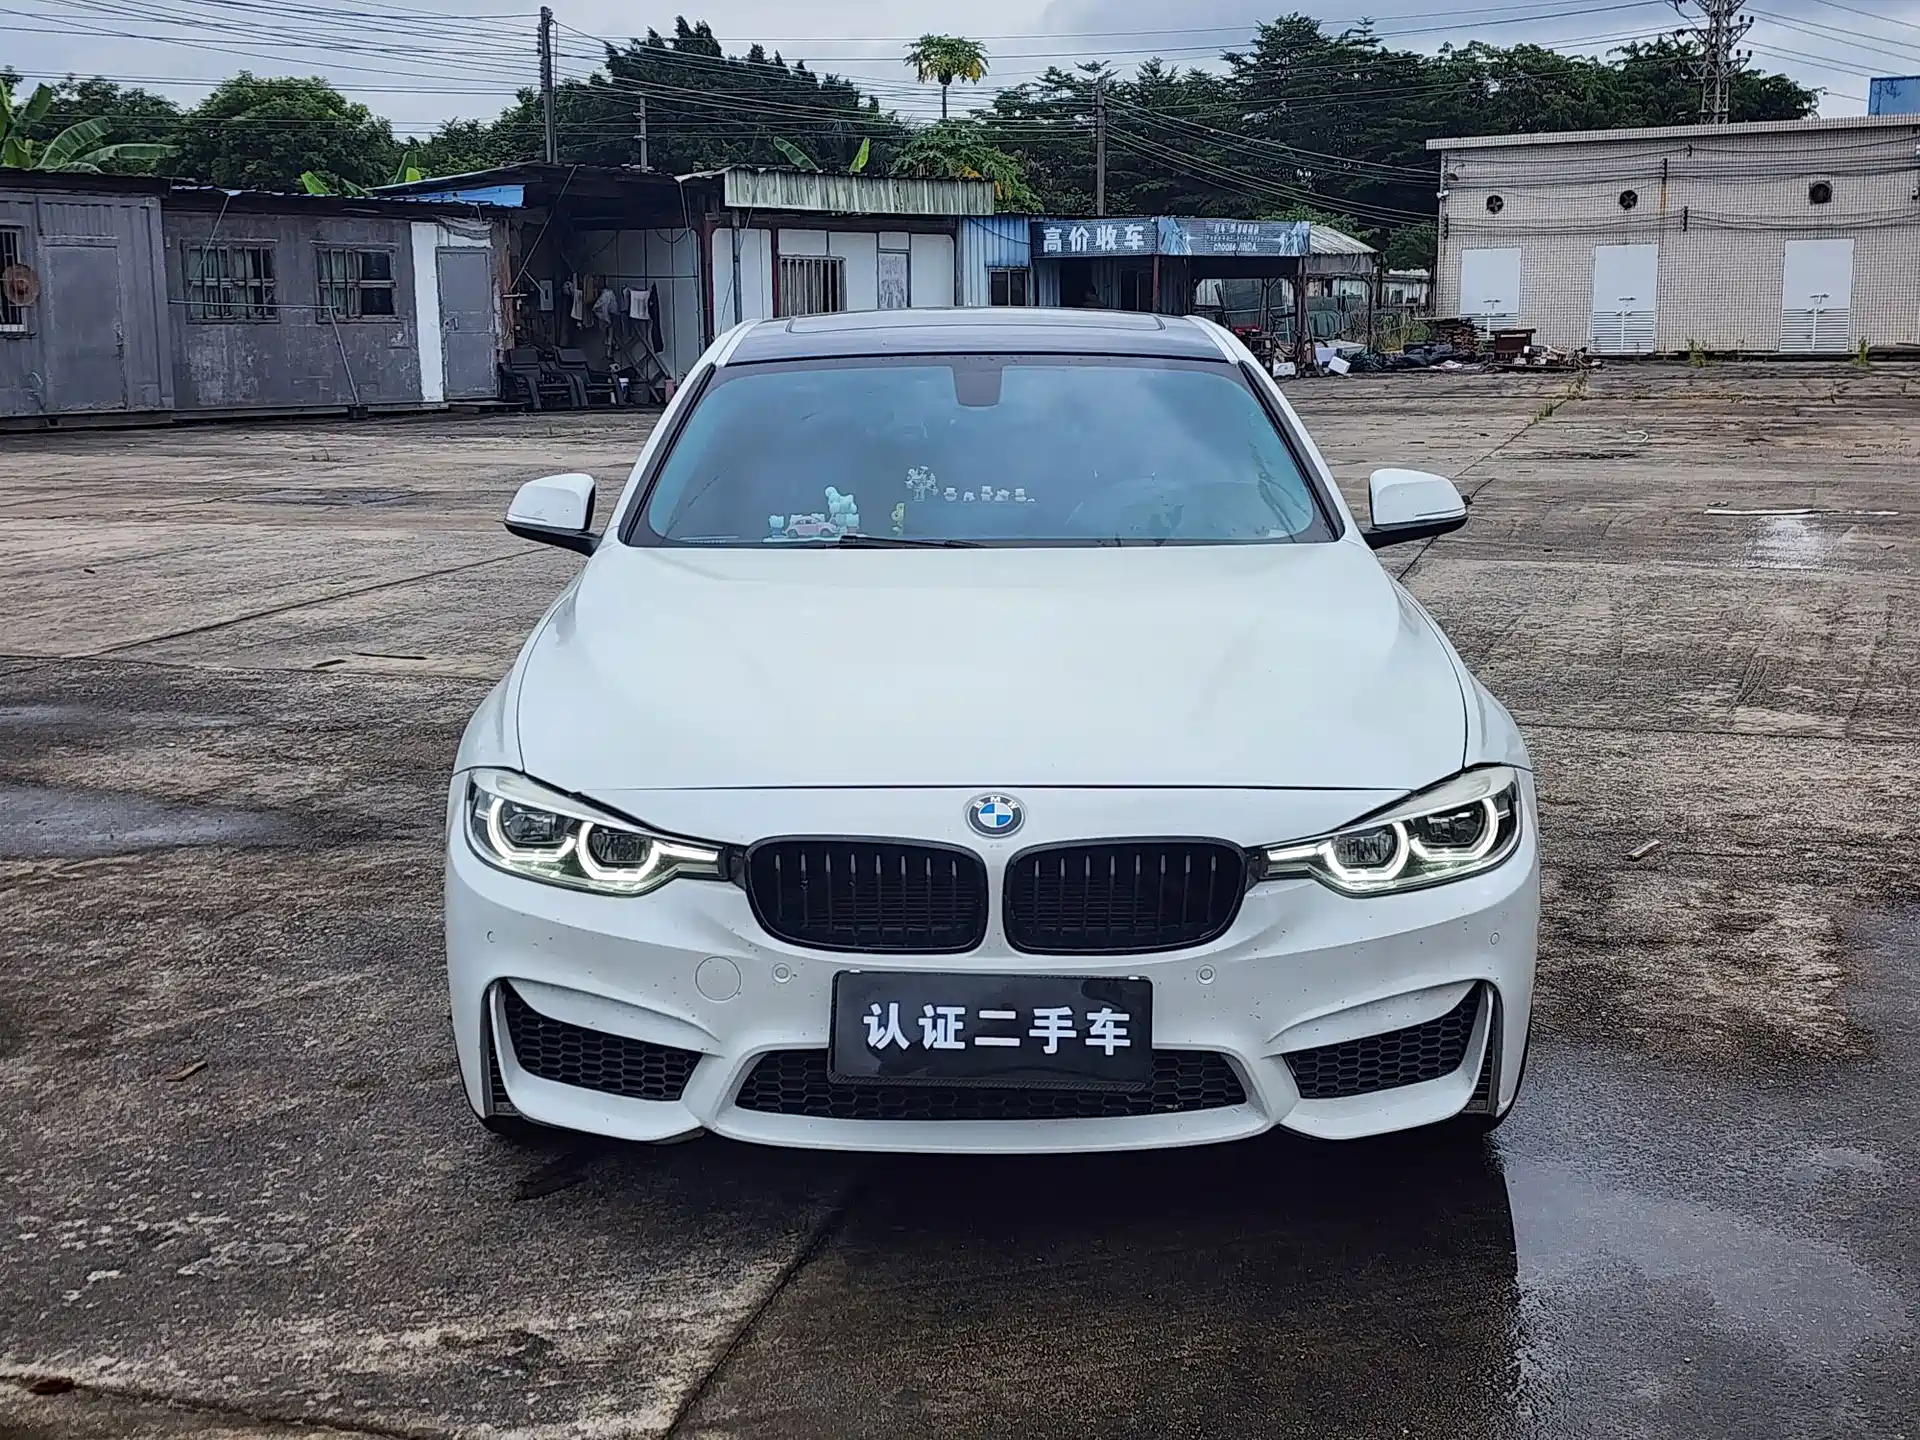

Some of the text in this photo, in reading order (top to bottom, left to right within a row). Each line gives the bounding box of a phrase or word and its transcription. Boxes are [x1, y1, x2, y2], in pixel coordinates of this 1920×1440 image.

[1043, 224, 1145, 252] 高价收车
[863, 1002, 1131, 1056] 认证二手车
